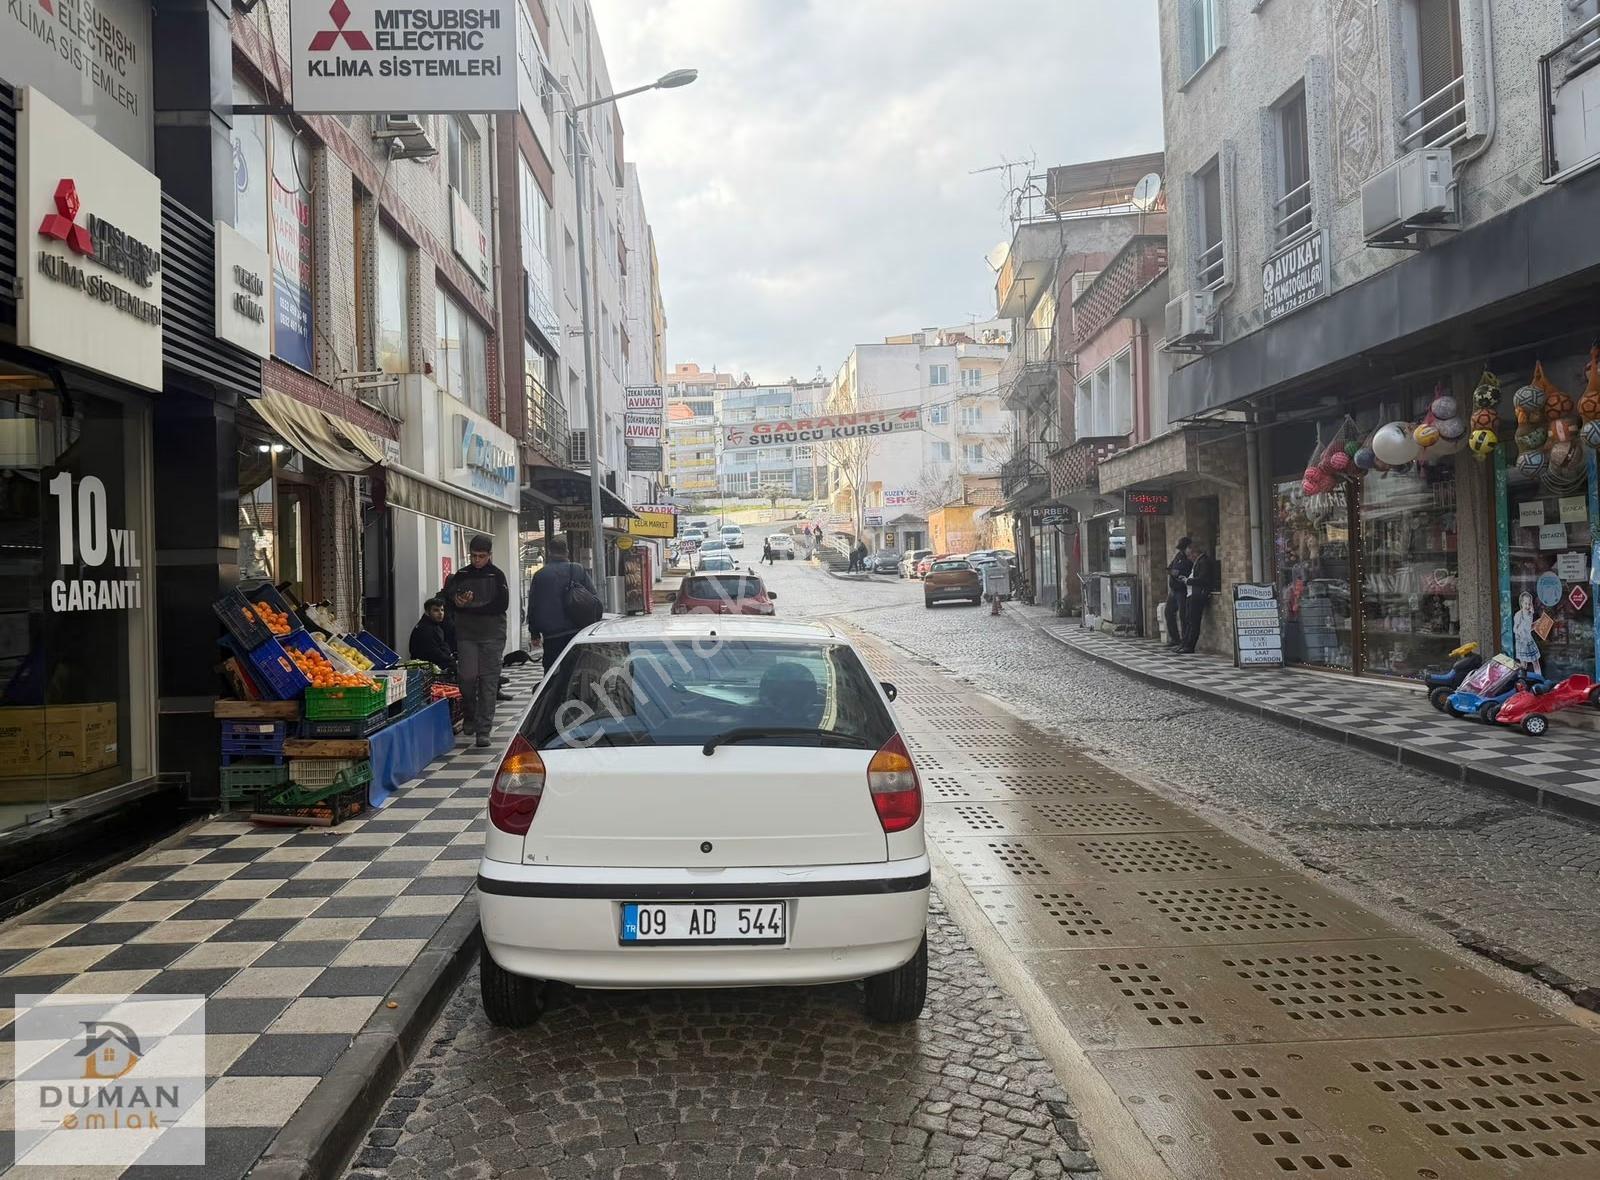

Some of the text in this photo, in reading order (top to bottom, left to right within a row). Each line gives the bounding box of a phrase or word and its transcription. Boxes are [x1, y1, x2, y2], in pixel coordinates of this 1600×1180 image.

[375, 9, 500, 29] MITSUBISHI
[58, 0, 126, 77] ELECTRIC
[375, 31, 484, 51] ELECTRIC
[59, 35, 138, 117] SİSTEMLERİ
[308, 55, 501, 77] KLİMA SİSTEMLERİ
[1275, 234, 1321, 283] AVUKAT
[38, 251, 88, 292] KLİMA
[1307, 287, 1316, 299] 07
[628, 398, 661, 407] AVUKAT
[626, 425, 660, 437] AVUKAT
[749, 429, 824, 446] SÜRÜCÜ
[831, 421, 893, 438] KURSU
[50, 472, 141, 568] 10 YIL
[649, 520, 669, 529] MARKET
[51, 573, 141, 612] GARANTİ
[625, 925, 637, 933] TR
[638, 908, 780, 935] 09 AD 544
